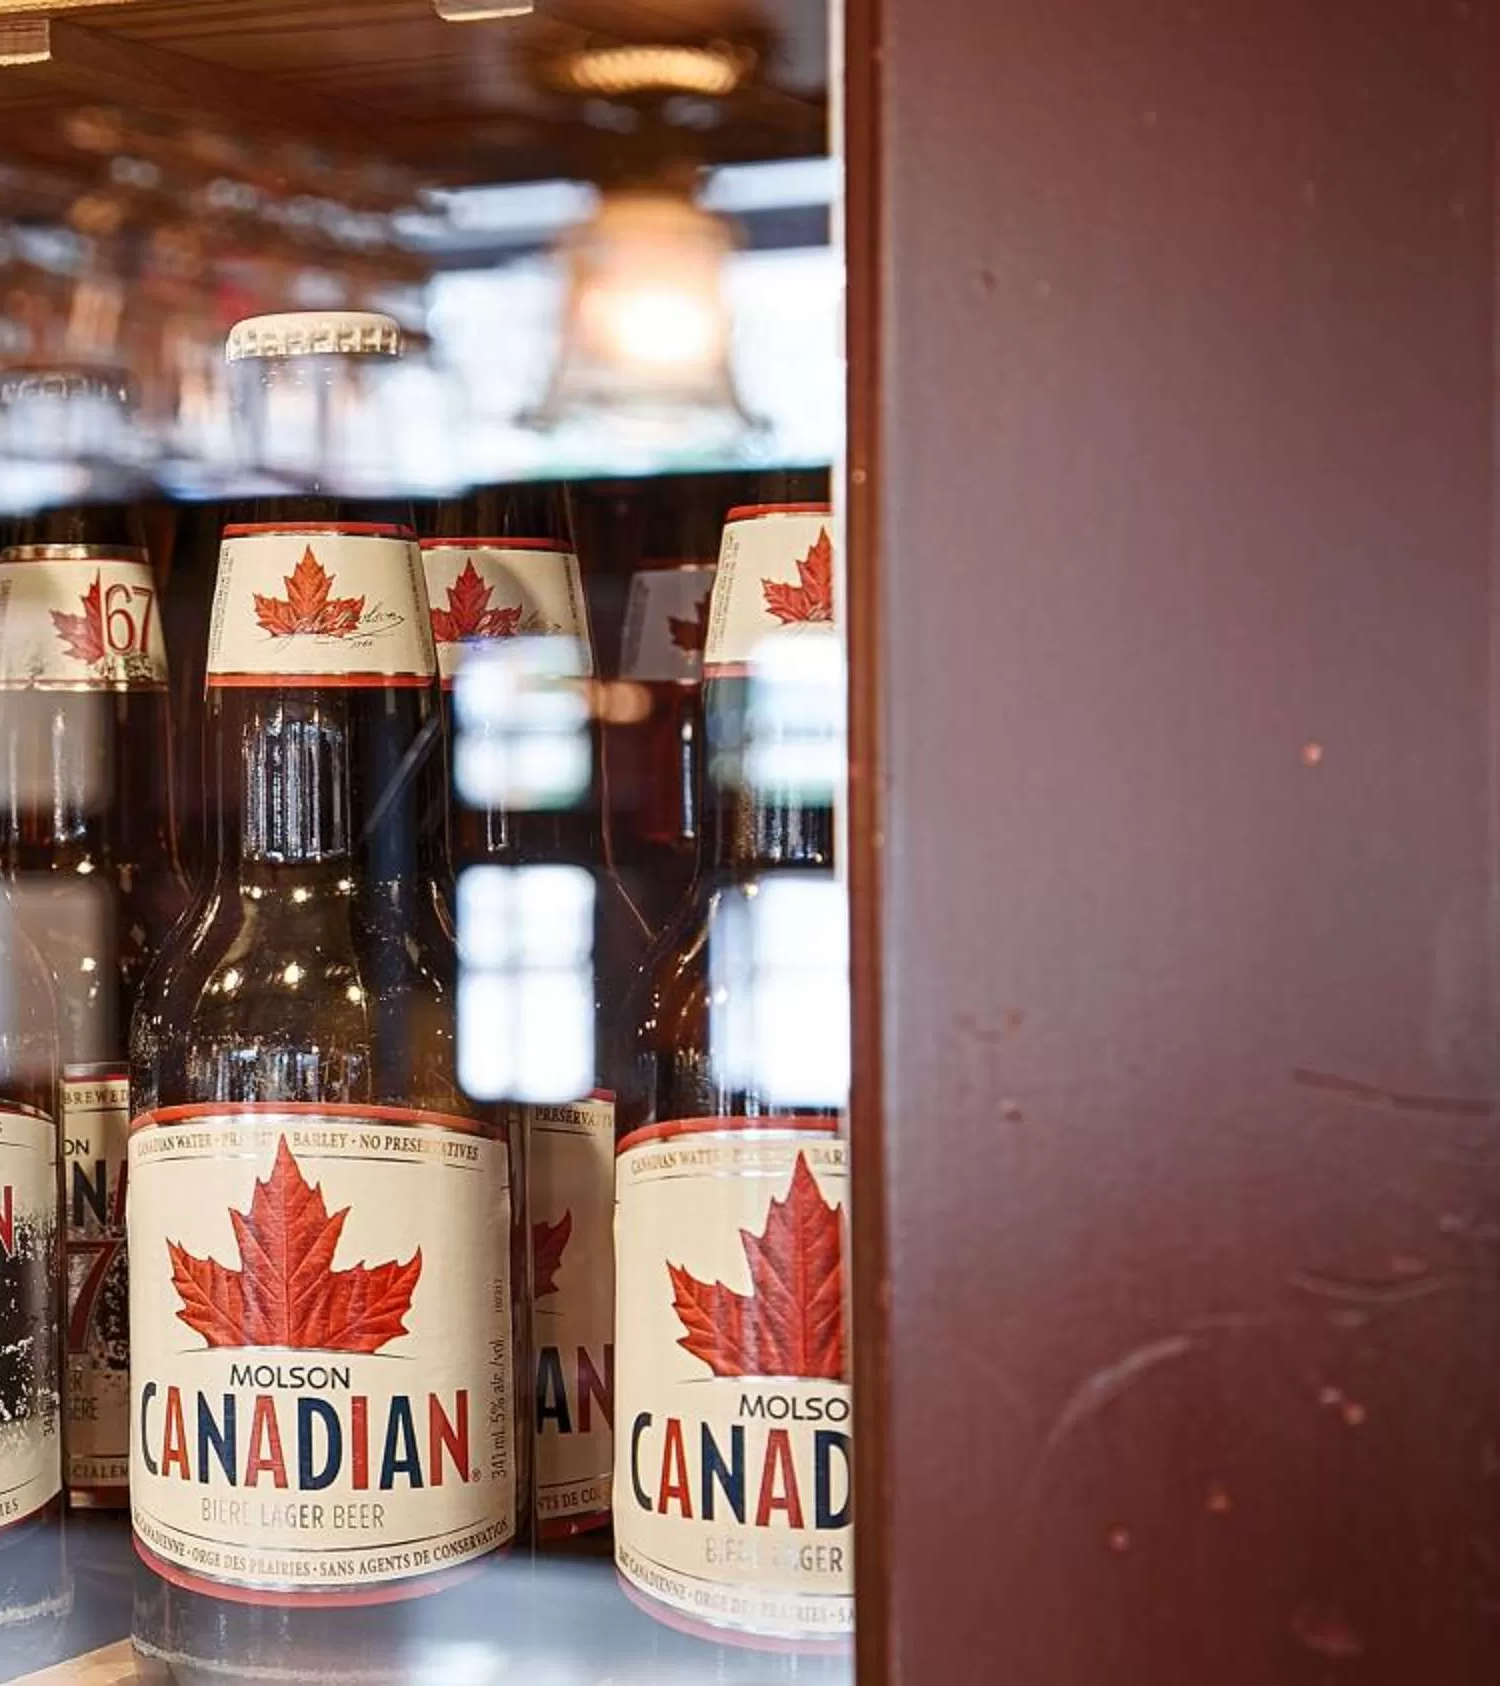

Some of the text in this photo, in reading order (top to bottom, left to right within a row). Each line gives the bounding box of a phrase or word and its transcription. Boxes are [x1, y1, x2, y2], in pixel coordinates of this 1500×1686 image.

[106, 582, 155, 656] 67
[359, 1133, 381, 1149] NO
[385, 1135, 480, 1161] PRESTIVES
[230, 1363, 351, 1389] MOLSON
[140, 1381, 471, 1491] CANADIAN
[260, 1503, 325, 1530] LAGER
[333, 1503, 385, 1530] BEER
[192, 1547, 221, 1568] ORGE
[224, 1554, 246, 1571] DES
[319, 1559, 355, 1577] SANS
[359, 1552, 411, 1576] AGENTS
[413, 1547, 431, 1568] DE
[433, 1518, 509, 1561] CONSERVATION
